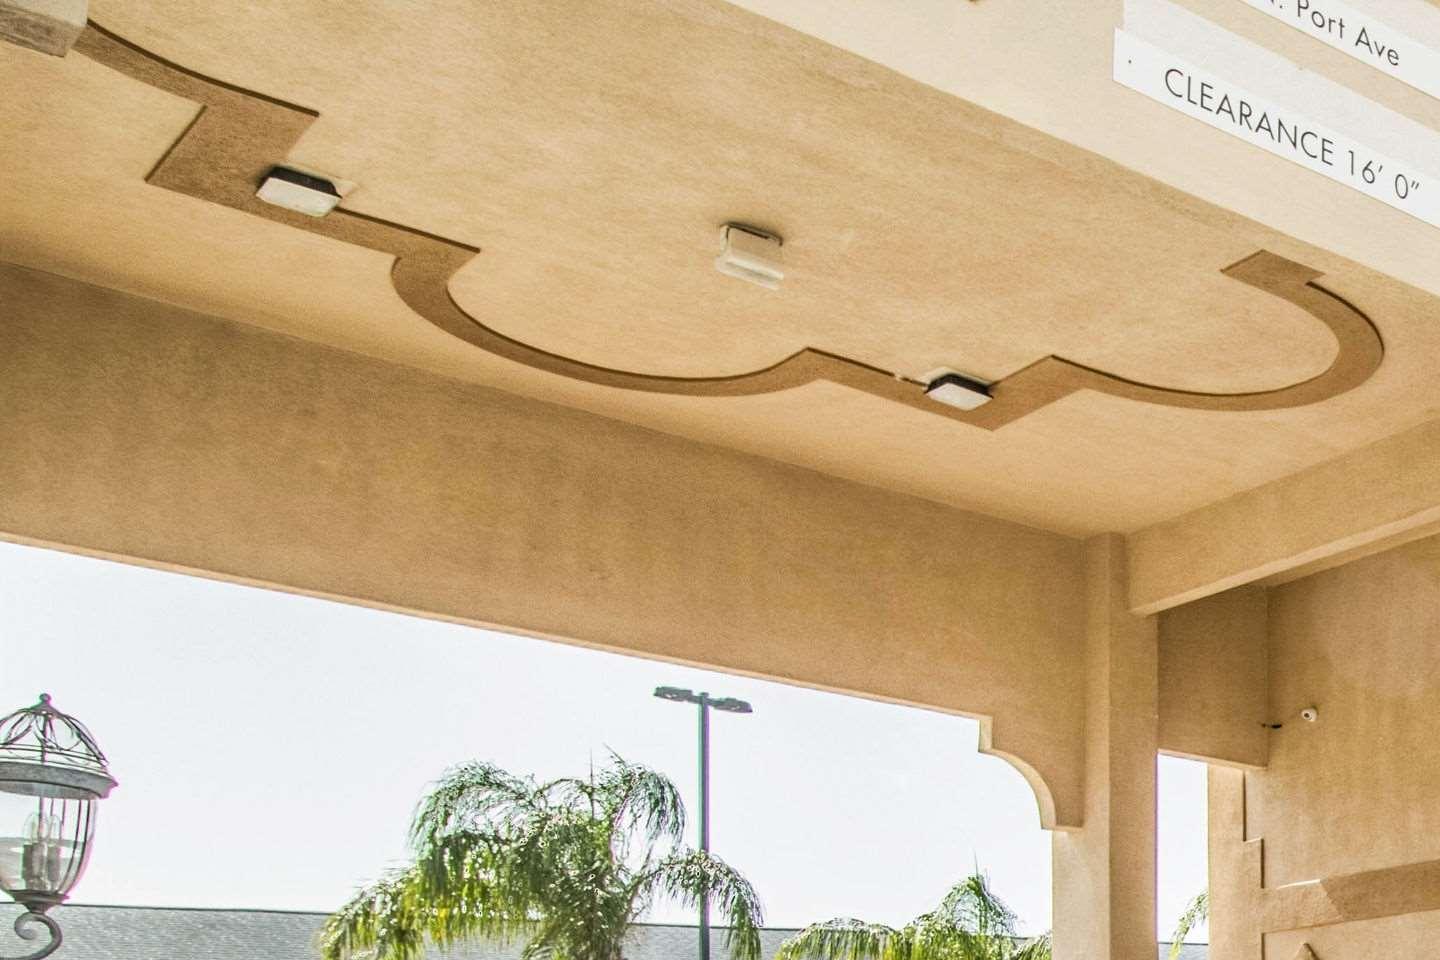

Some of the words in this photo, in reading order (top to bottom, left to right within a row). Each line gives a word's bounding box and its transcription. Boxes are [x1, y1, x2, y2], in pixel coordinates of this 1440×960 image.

[1297, 0, 1345, 39] Port
[1354, 27, 1400, 66] Ave
[1164, 68, 1333, 166] CLEARANCE
